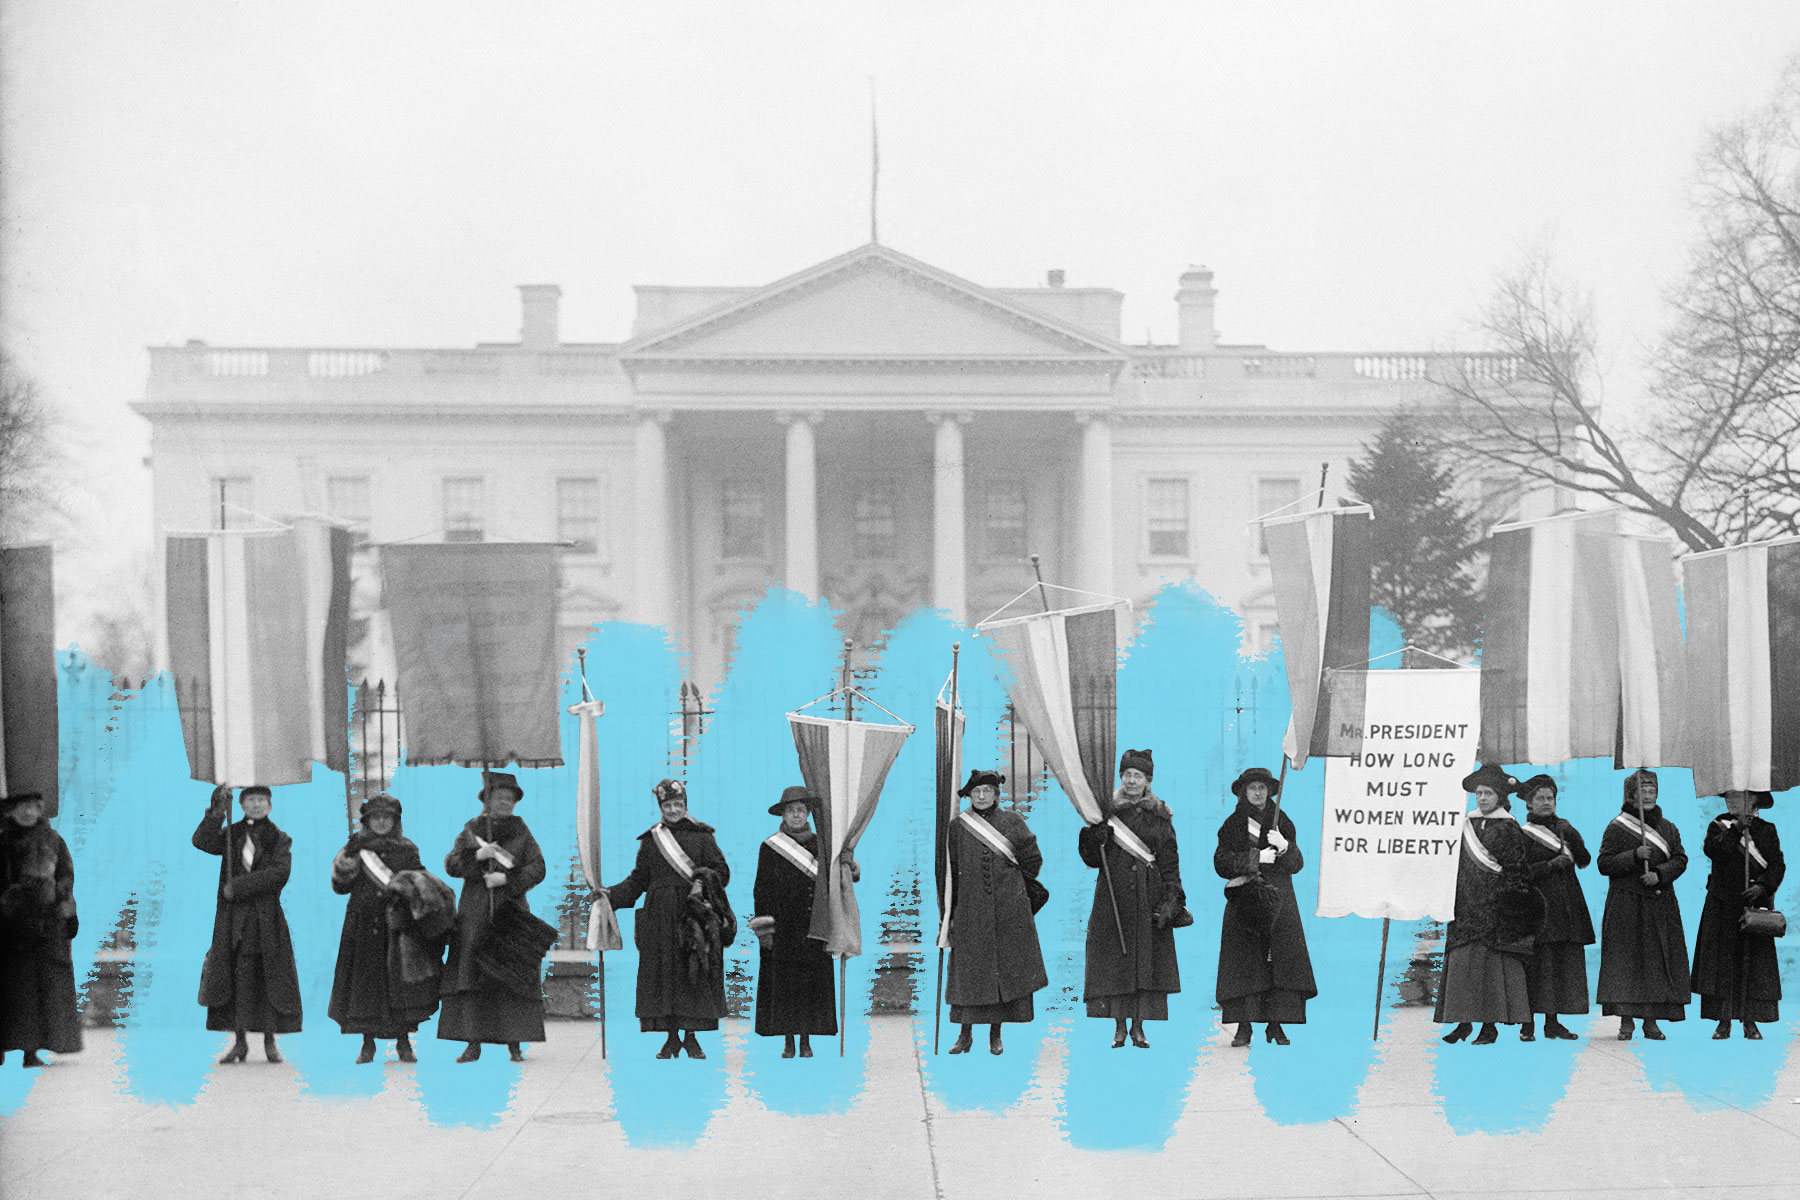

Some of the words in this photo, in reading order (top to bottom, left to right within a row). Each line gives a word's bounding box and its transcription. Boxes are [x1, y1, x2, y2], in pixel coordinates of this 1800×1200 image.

[1370, 724, 1468, 740] PRESIDENT
[1349, 752, 1395, 768] HOW
[1403, 752, 1456, 768] LONG
[1366, 781, 1428, 797] MUST
[1335, 808, 1404, 825] WOMEN
[1412, 810, 1460, 826] WAIT
[1334, 837, 1368, 853] FOR
[1377, 838, 1458, 855] LIBERTY
